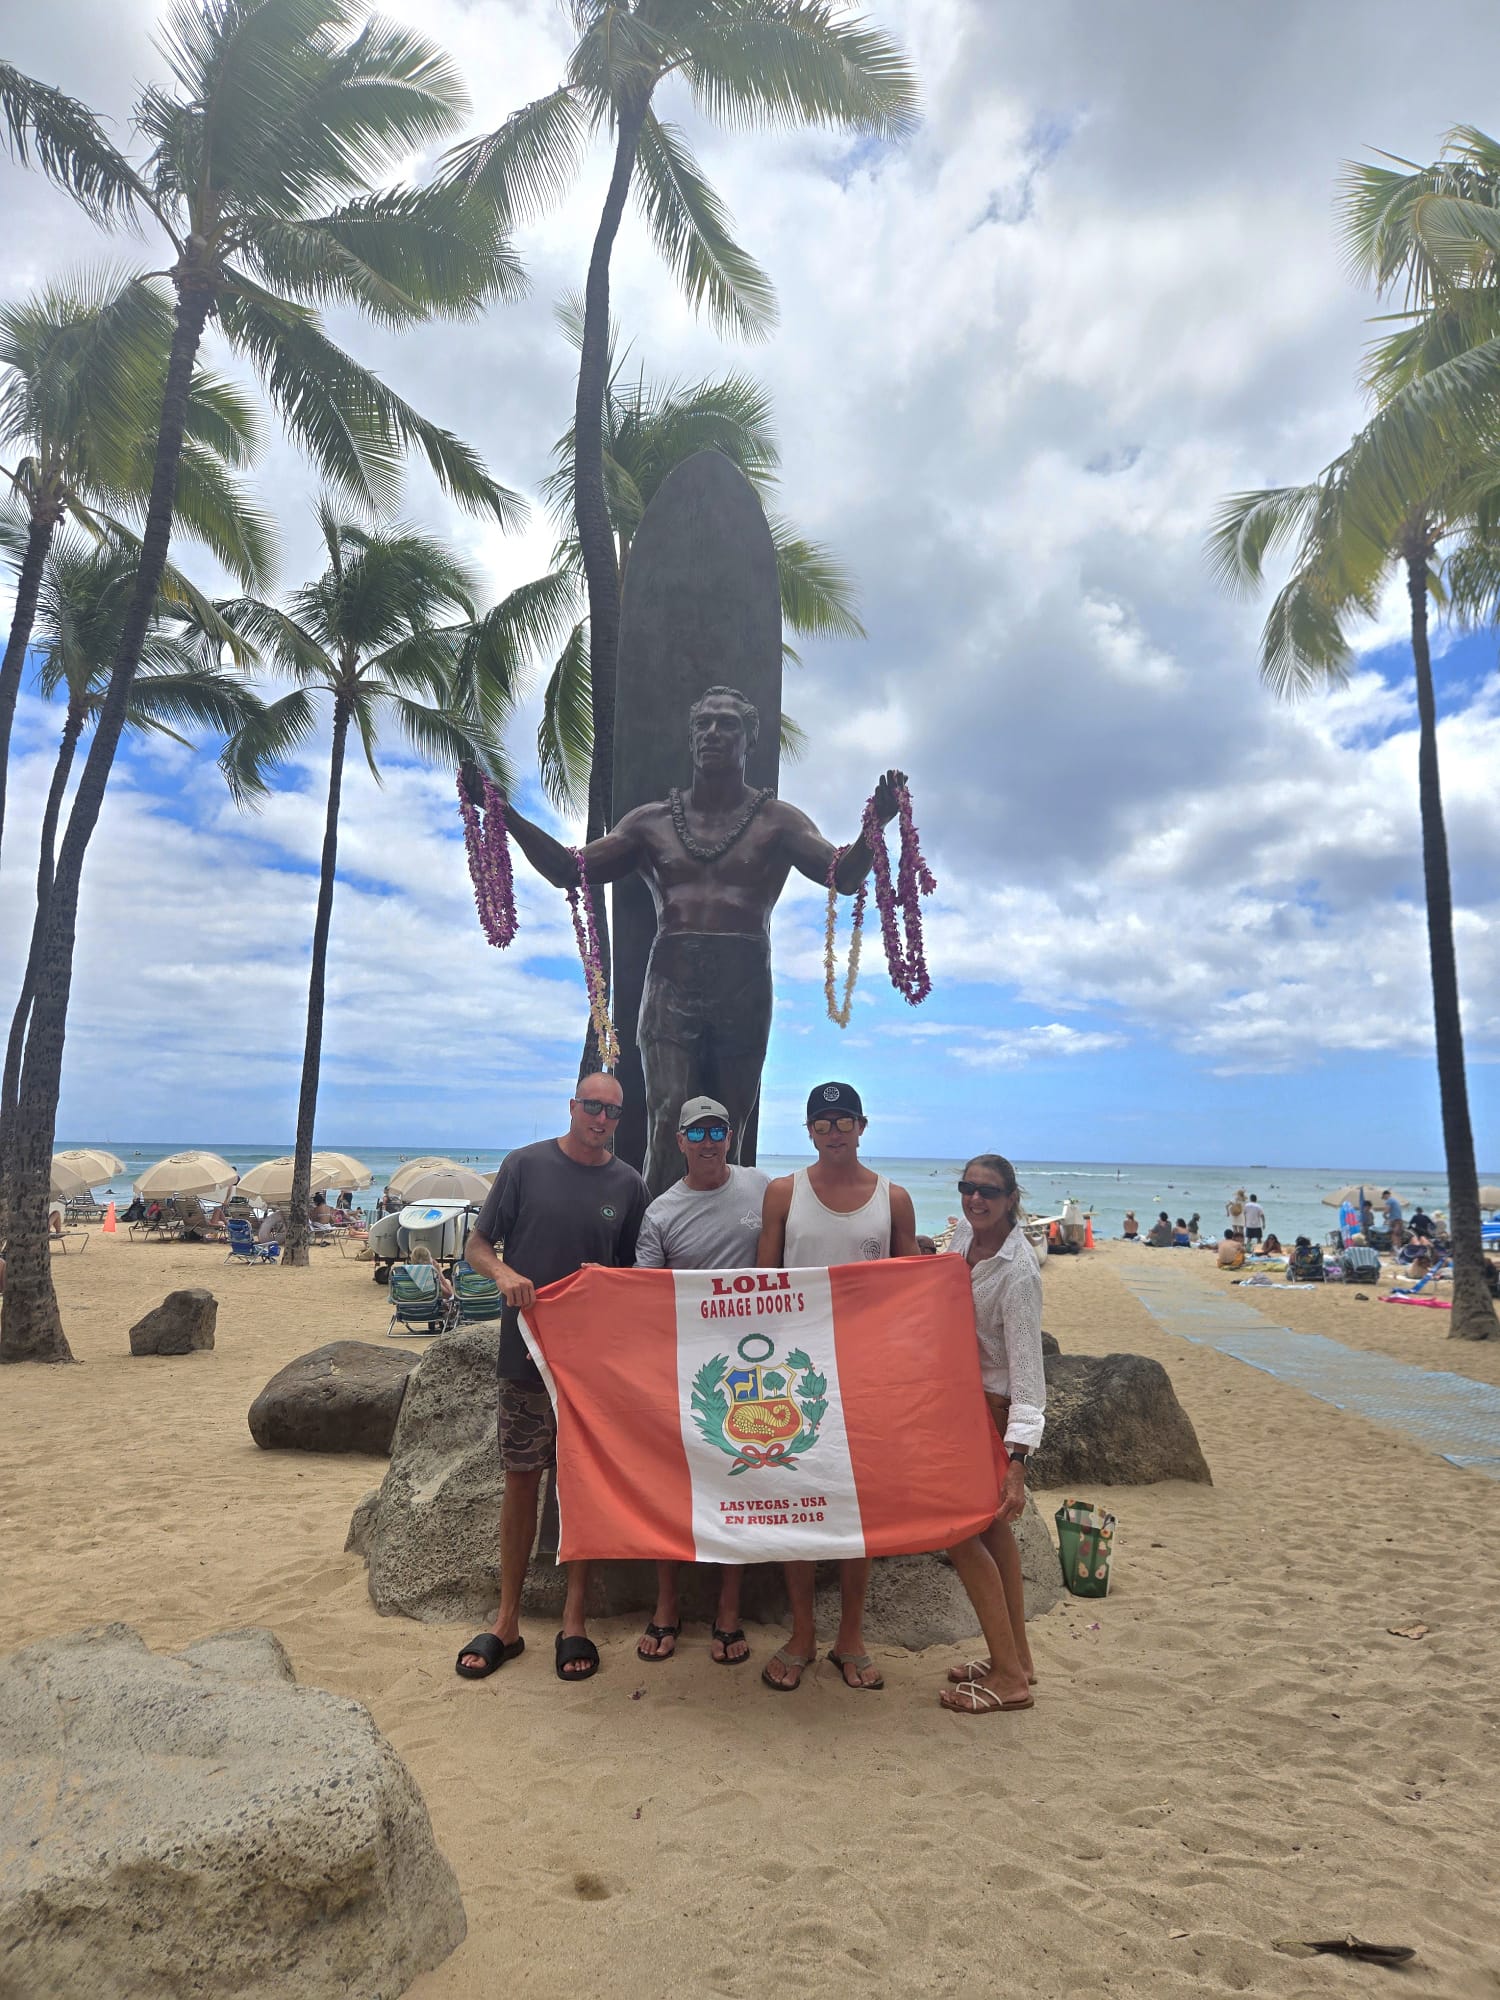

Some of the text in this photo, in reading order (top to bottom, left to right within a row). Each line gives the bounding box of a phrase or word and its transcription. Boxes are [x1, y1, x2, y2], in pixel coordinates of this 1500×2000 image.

[711, 1272, 791, 1295] LOLI
[700, 1293, 805, 1319] GARAGE DOOR'S
[720, 1501, 745, 1511] LAS
[746, 1499, 790, 1511] VEGAS
[800, 1496, 827, 1508] USA
[725, 1512, 824, 1525] EN RUSIA 2018
